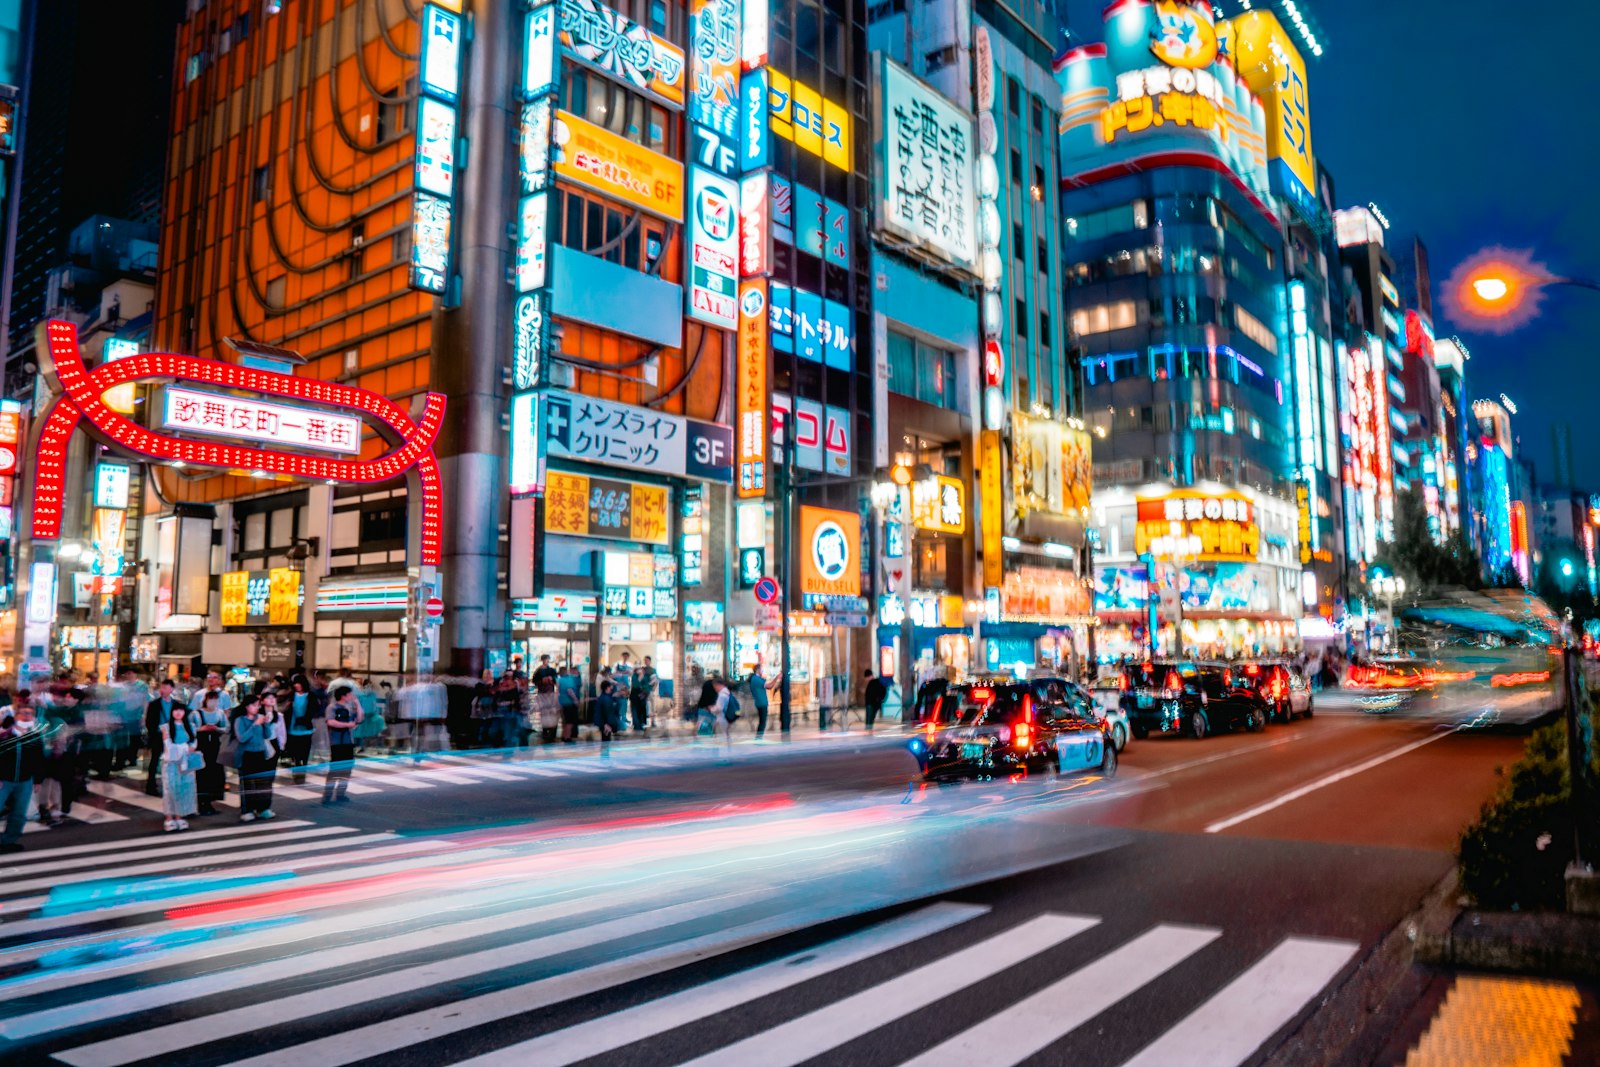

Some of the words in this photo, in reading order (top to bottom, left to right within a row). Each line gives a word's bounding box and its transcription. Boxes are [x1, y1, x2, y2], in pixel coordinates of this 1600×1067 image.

[769, 87, 842, 148] プロミス
[697, 126, 736, 174] 7F
[654, 179, 676, 203] 6F
[419, 267, 445, 289] 7F
[696, 290, 735, 319] ATM
[769, 305, 849, 351] セントラル
[175, 396, 352, 445] 歌舞伎町一番街
[576, 403, 677, 440] メンズライフ
[771, 404, 847, 453] アコム
[575, 431, 659, 465] クリニック
[695, 436, 725, 466] 3F
[643, 491, 667, 514] ビール
[643, 518, 667, 539] サワー
[807, 578, 826, 590] BUY
[833, 580, 855, 592] SELL
